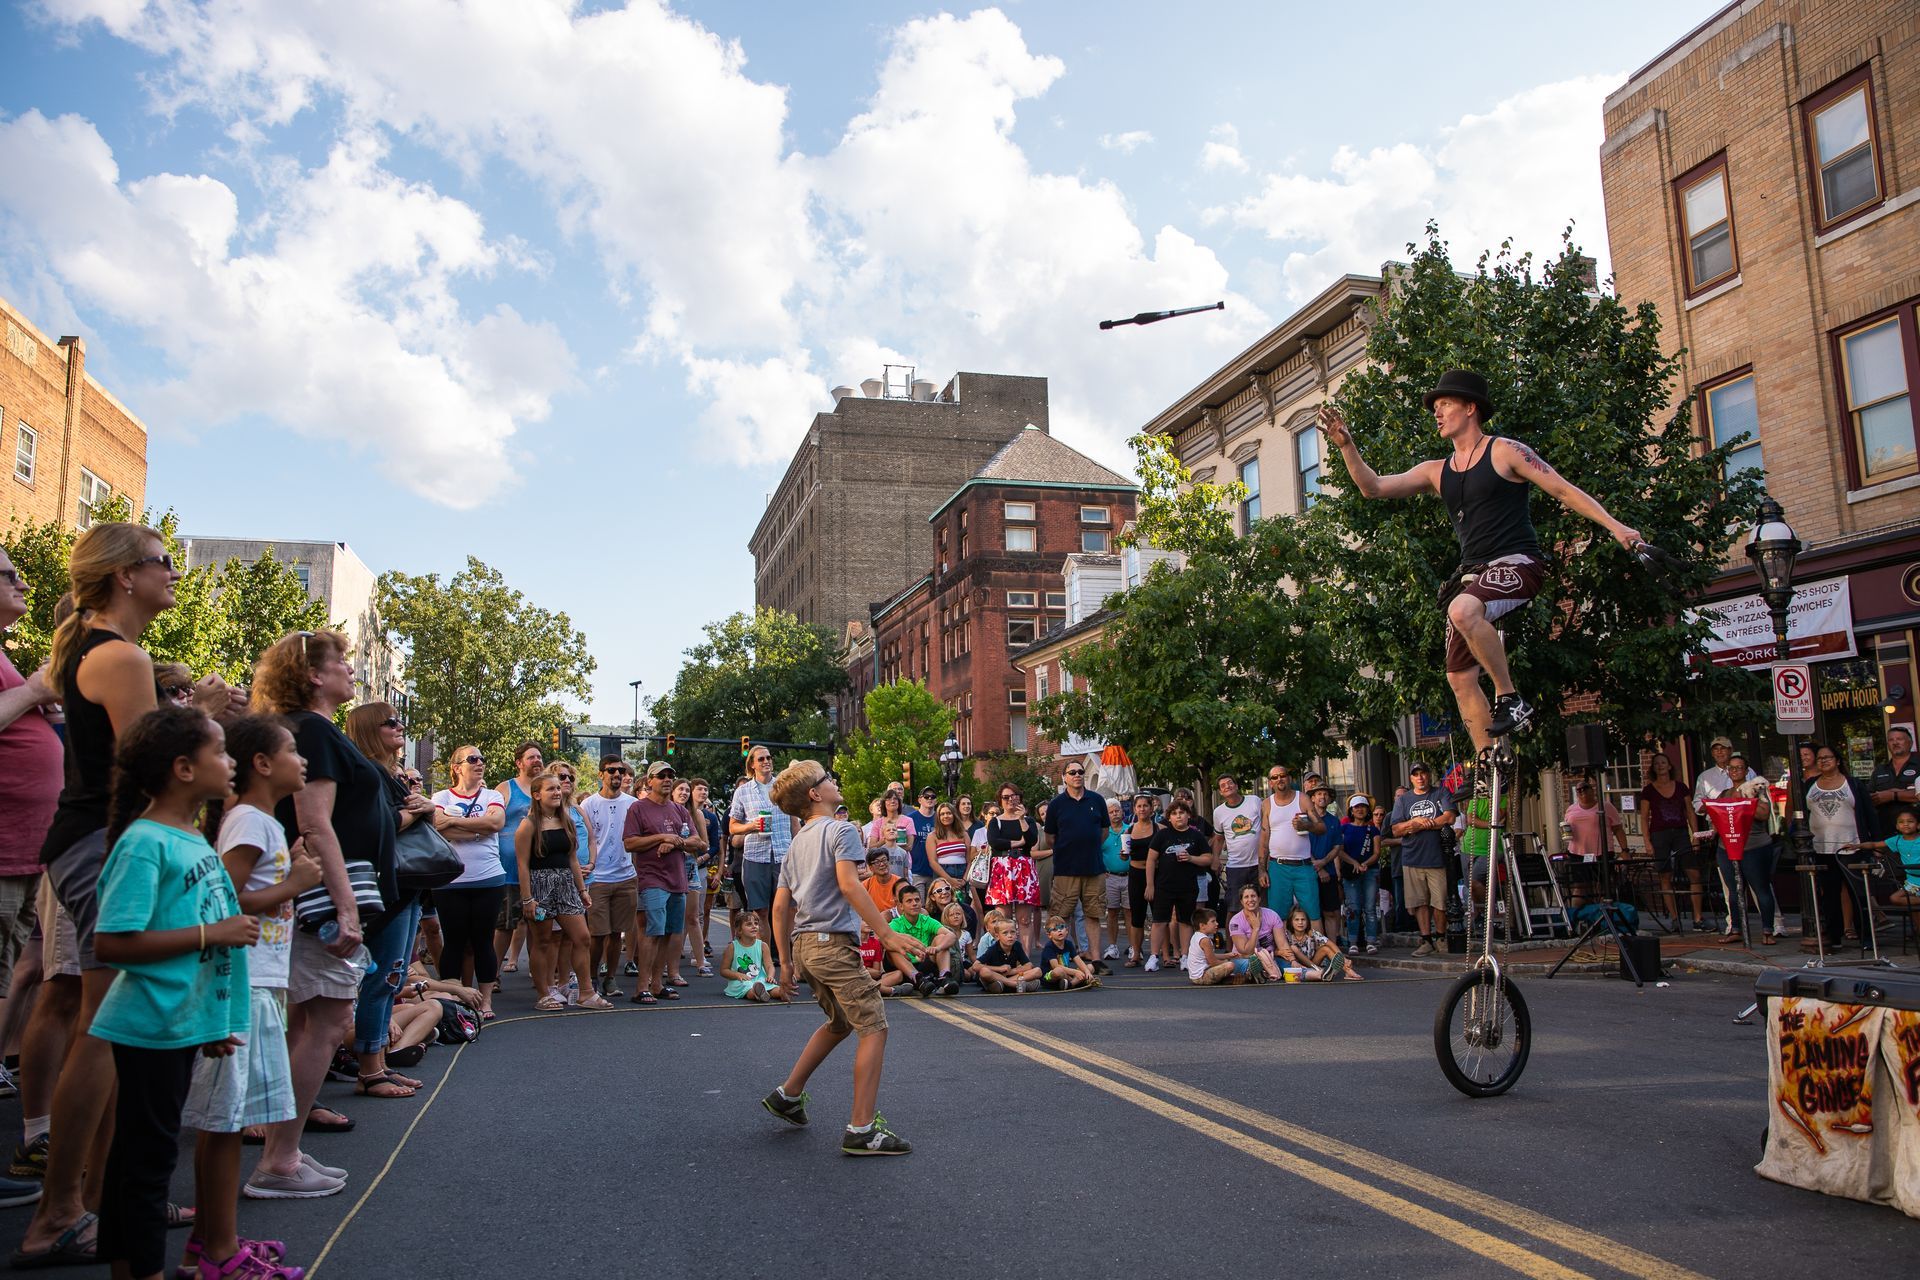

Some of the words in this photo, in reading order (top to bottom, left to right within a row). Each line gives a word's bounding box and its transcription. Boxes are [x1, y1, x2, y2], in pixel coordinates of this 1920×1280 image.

[1745, 600, 1755, 610] 24
[1796, 589, 1808, 600] $5
[1809, 582, 1840, 597] SHOTS
[1737, 611, 1767, 624] PIZZAS
[1788, 598, 1833, 615] DWICHES
[1737, 647, 1778, 662] CORKE
[1821, 691, 1850, 711] HAPPY
[1851, 688, 1880, 708] HOUR
[1778, 1012, 1806, 1032] THE
[1780, 1033, 1869, 1074] FLAMING
